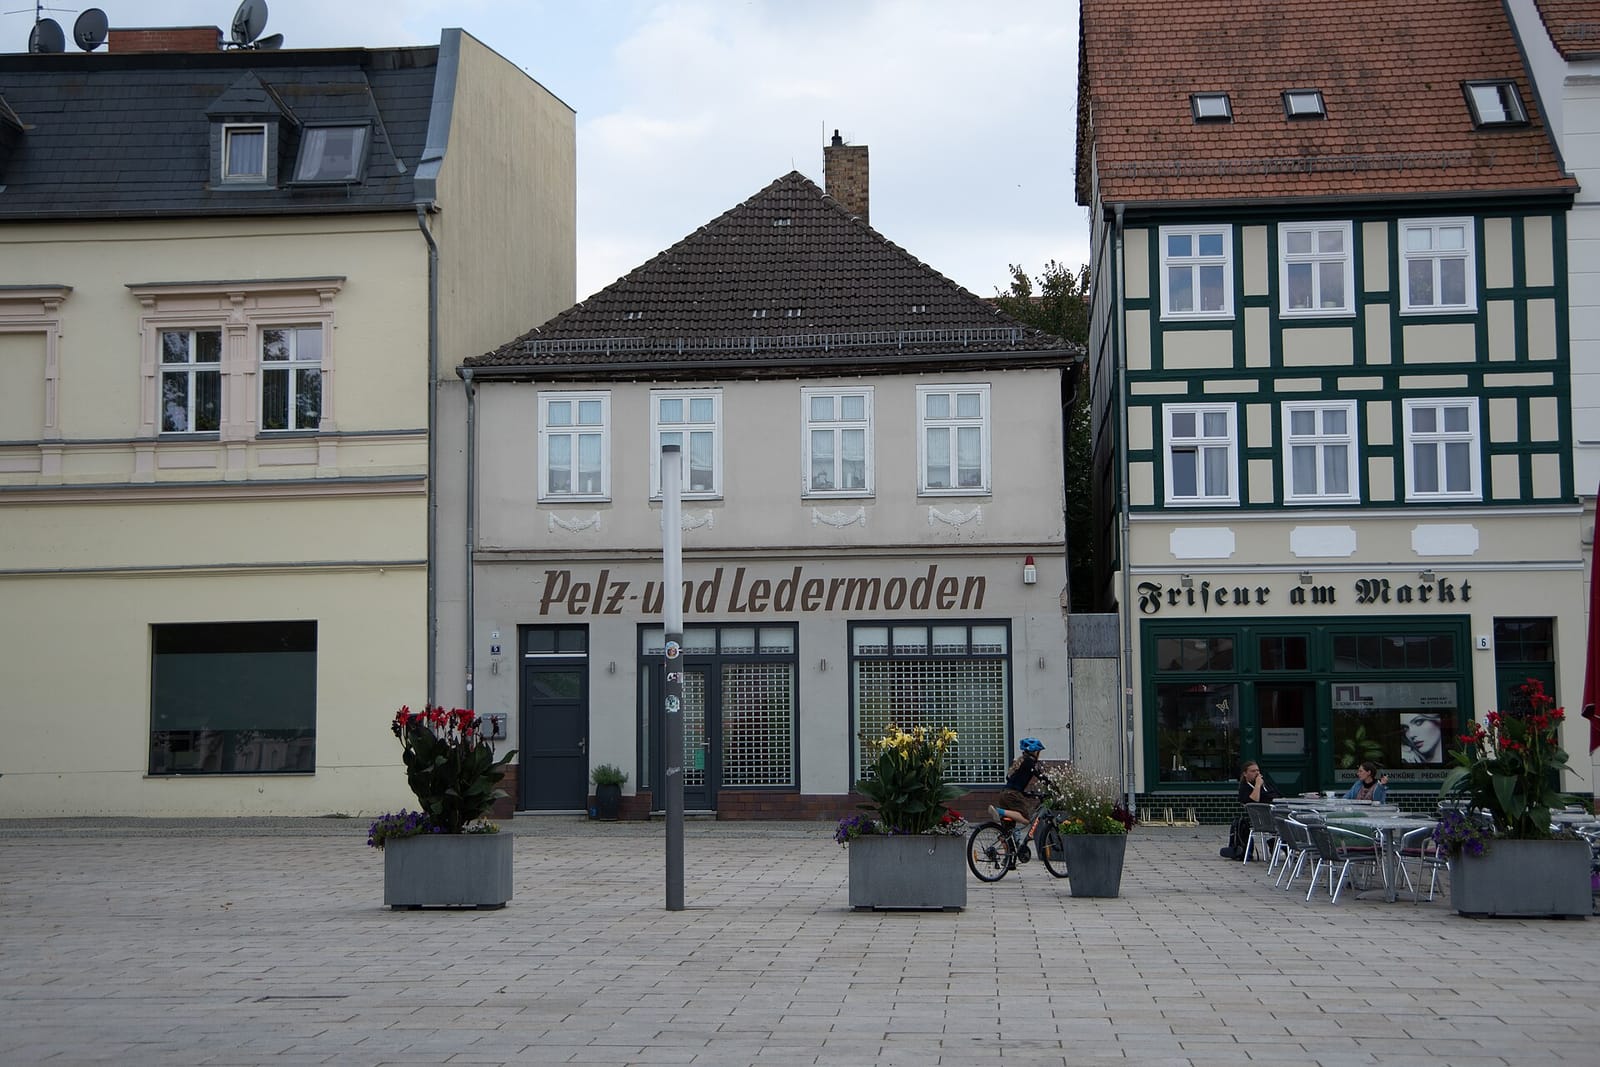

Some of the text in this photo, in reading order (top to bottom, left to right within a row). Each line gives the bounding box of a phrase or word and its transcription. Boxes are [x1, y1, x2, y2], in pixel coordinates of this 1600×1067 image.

[727, 564, 987, 613] Ledermoden
[1289, 585, 1337, 606] am
[1354, 577, 1472, 604] Markt
